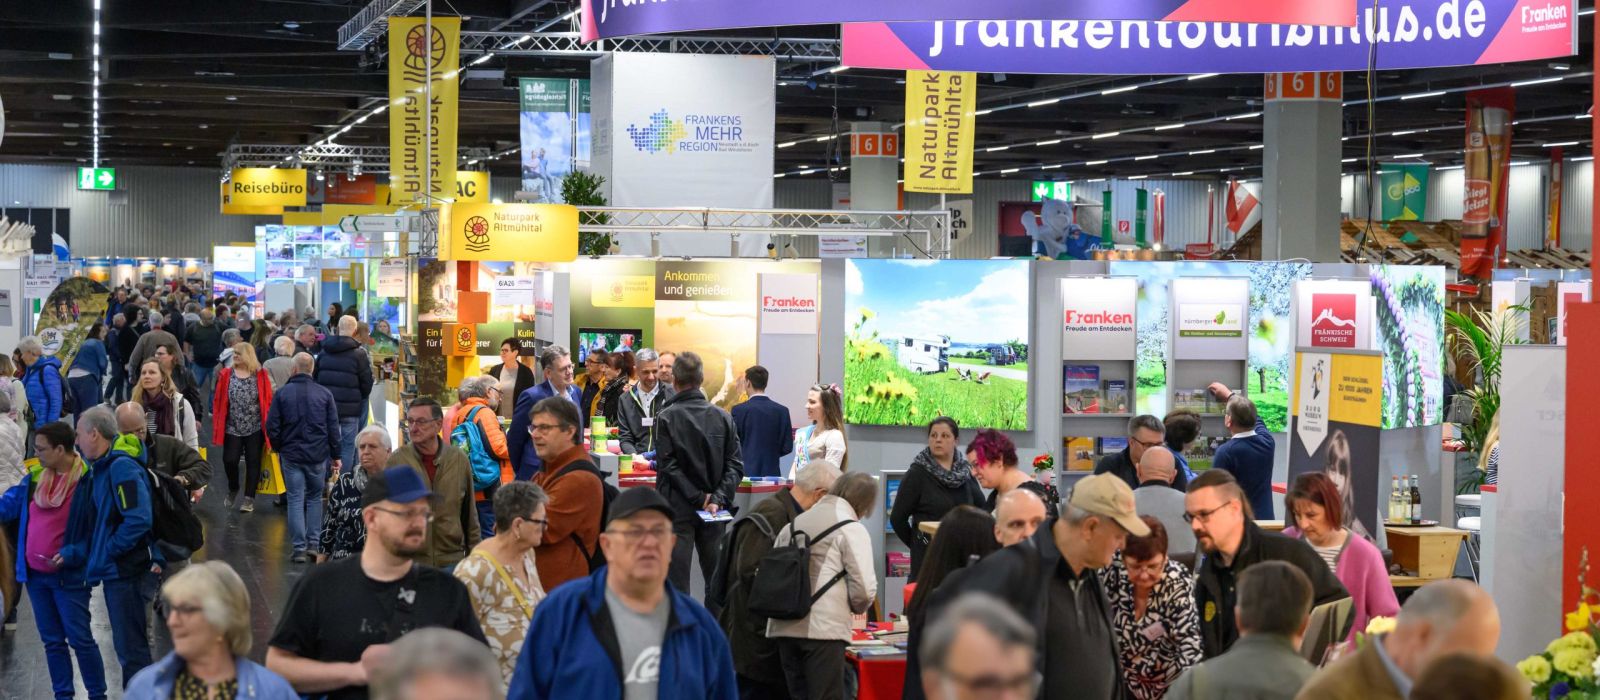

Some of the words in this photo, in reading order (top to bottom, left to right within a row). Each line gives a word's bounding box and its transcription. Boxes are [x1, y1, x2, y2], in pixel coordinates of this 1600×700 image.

[1521, 3, 1567, 24] Franken
[1292, 73, 1304, 92] 6
[1326, 72, 1334, 92] 6
[685, 115, 742, 125] FRANKENS
[919, 72, 942, 179] Naturpark
[696, 126, 742, 141] MEHR
[941, 75, 962, 180] Altmühlta
[680, 142, 718, 151] REGION
[864, 138, 873, 151] 6
[886, 138, 893, 151] 6
[234, 181, 303, 194] Reisebüro
[494, 212, 540, 223] Naturpark
[493, 223, 542, 232] Altmühltal
[664, 270, 721, 281] Ankommen
[664, 284, 683, 295] und
[685, 284, 734, 298] genießen
[763, 296, 815, 307] Franken
[1065, 310, 1132, 324] Franken
[426, 328, 438, 336] Ein
[517, 329, 535, 337] Kulin
[426, 339, 438, 347] für
